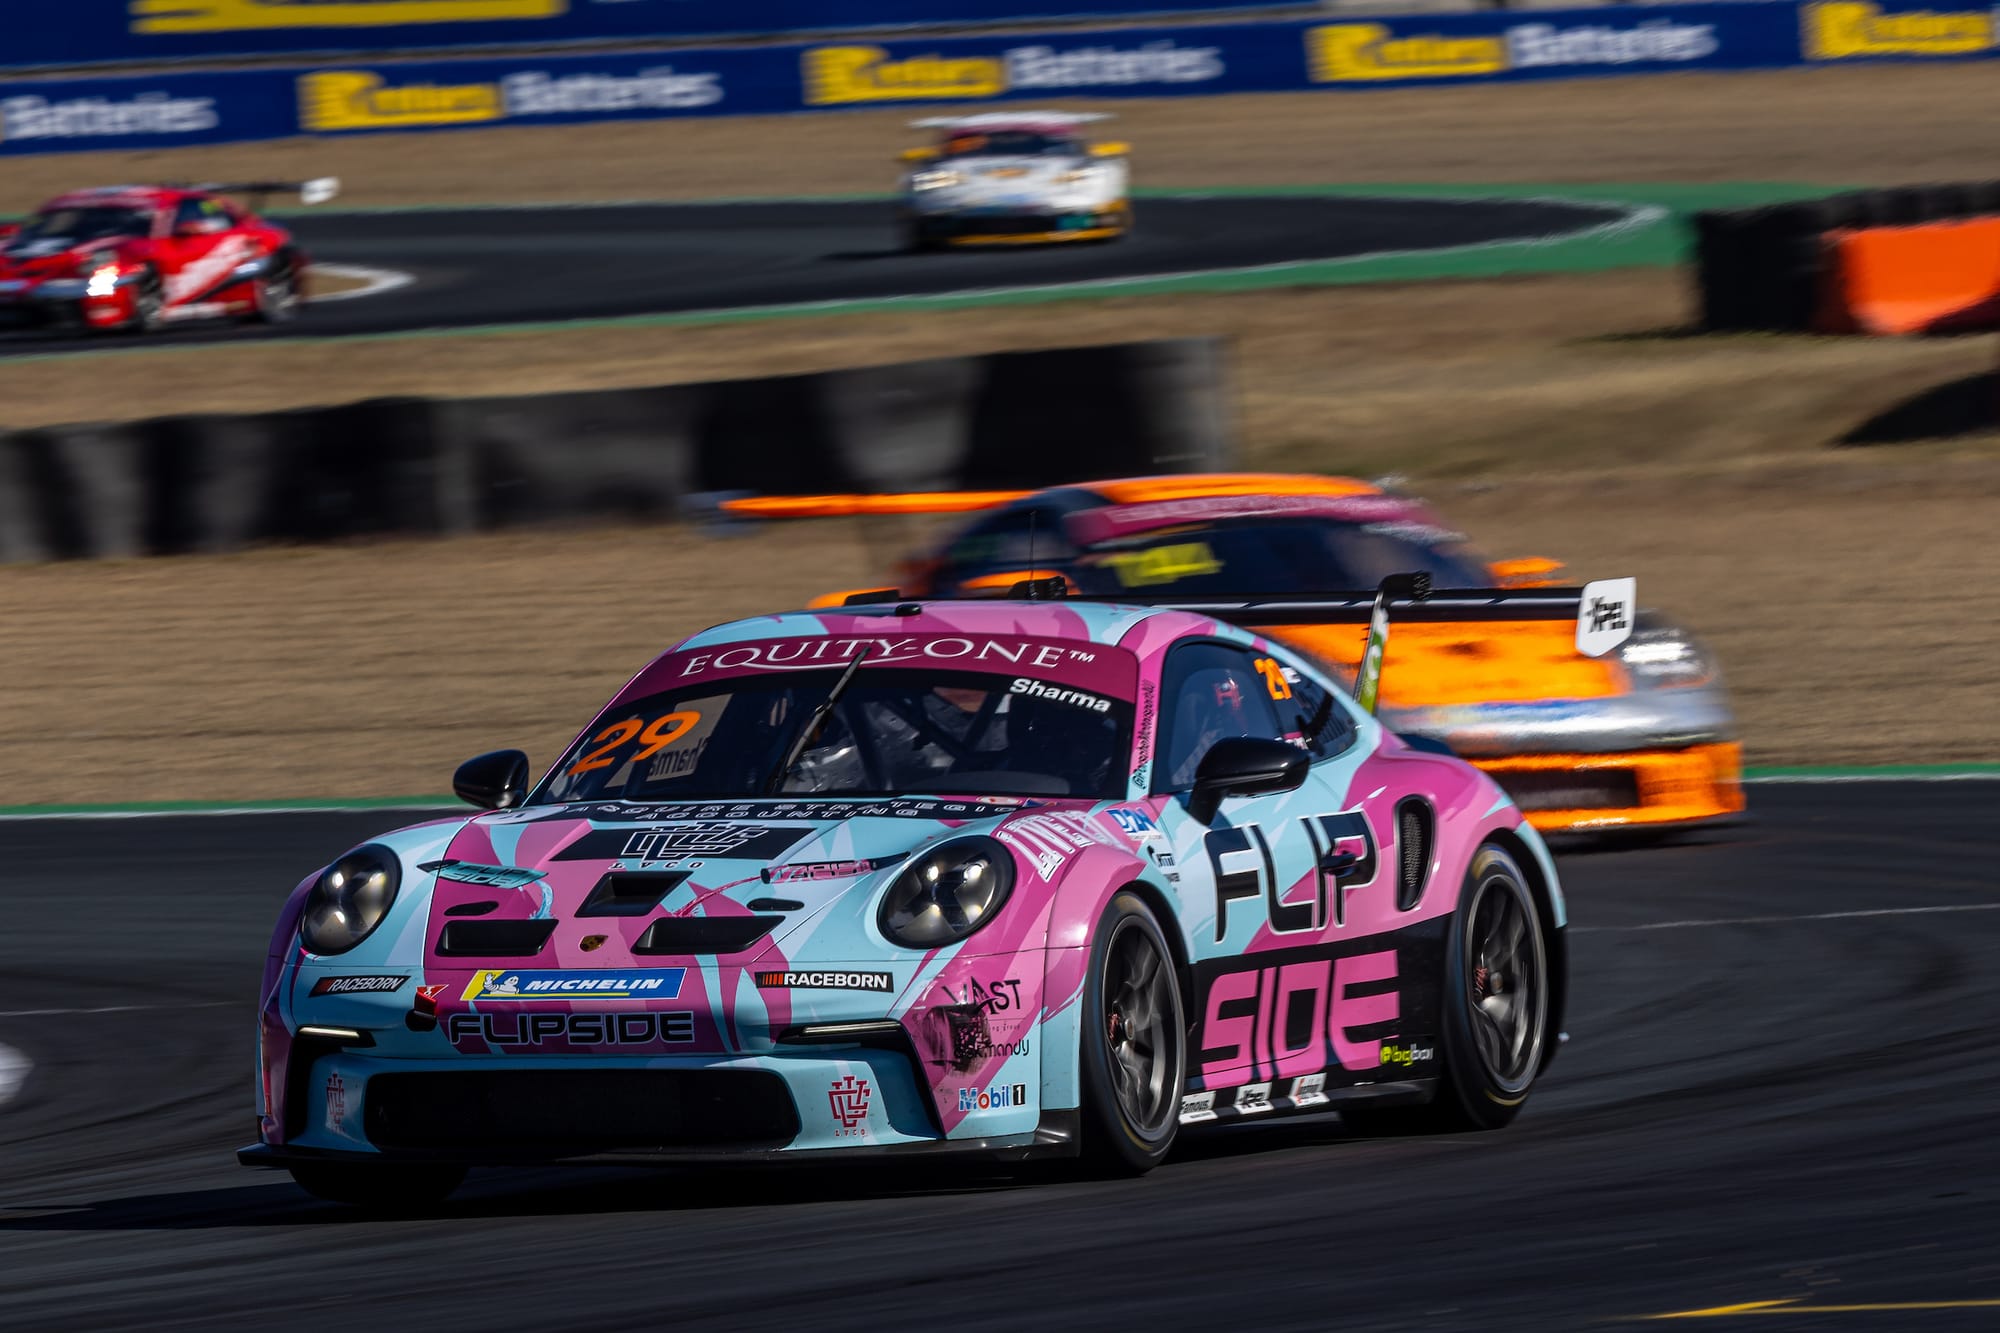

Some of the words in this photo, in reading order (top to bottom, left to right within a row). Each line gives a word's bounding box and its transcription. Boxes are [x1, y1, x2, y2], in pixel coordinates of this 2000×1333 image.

[1010, 678, 1111, 713] Sharma
[567, 711, 702, 777] 29
[1203, 808, 1382, 944] FLIP
[328, 976, 403, 992] RACEBORN
[523, 978, 665, 992] MICHELIN
[784, 973, 889, 988] RACEBORN
[448, 1011, 696, 1045] FLIPSIDE
[1201, 950, 1400, 1091] SIDE
